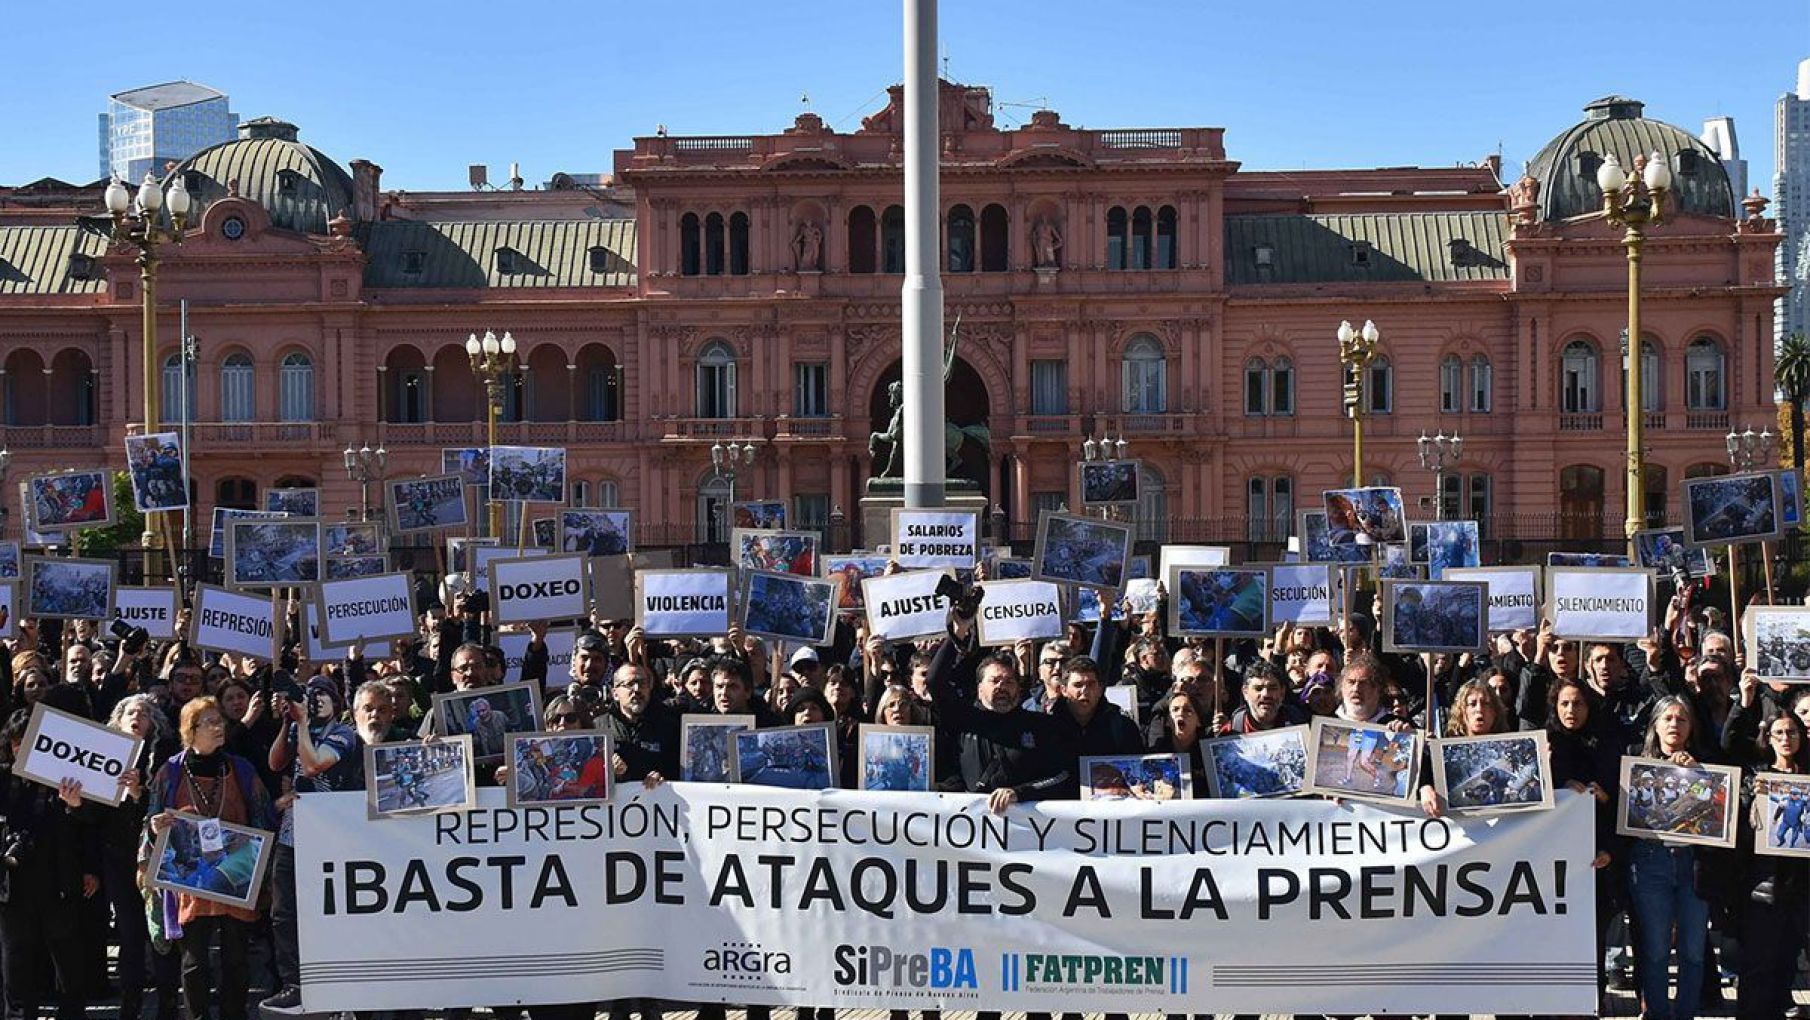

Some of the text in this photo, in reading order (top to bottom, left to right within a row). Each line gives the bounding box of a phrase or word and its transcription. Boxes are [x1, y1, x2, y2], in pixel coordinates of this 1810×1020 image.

[908, 524, 963, 537] SALARIOS
[900, 543, 973, 556] DE POBREZA
[500, 579, 580, 600] DOXEO
[114, 607, 167, 620] AJUSTE
[328, 596, 408, 620] PERSECUCIÓN
[646, 595, 724, 611] VIOLENCIA
[881, 594, 944, 618] AJUSTE
[984, 602, 1058, 620] CENSURA
[1558, 597, 1643, 613] SILENCIAMIENTO
[34, 734, 123, 777] DOXEO
[435, 796, 1451, 856] REPRESIÓN, PERSECUCIÓN Y SILENCIAMIENTO
[322, 851, 1569, 920] ¡BASTA DE ATAQUES A LA PRENSA!
[834, 944, 978, 989] SiPreBA
[1026, 954, 1164, 984] FATPREN
